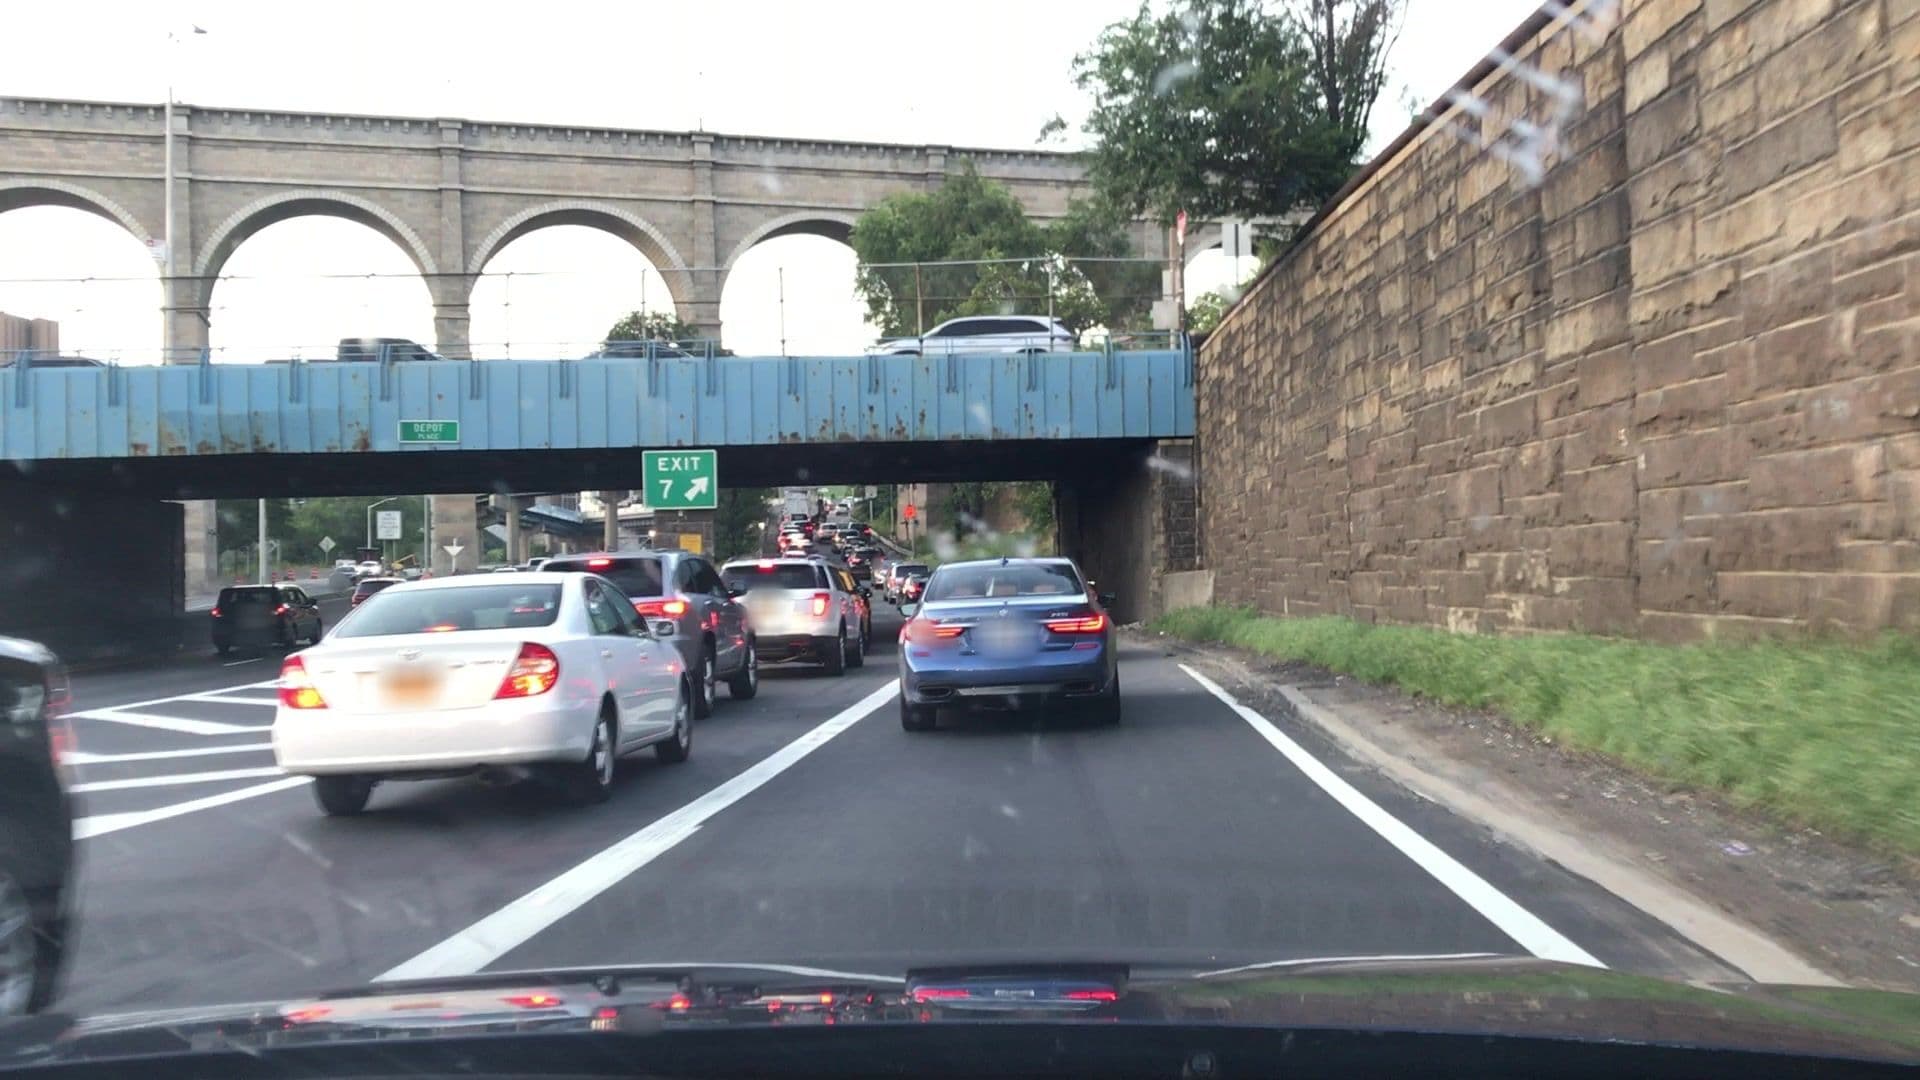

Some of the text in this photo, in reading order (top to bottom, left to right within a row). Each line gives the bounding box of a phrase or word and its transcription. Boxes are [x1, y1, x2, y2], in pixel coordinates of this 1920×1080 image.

[413, 423, 443, 433] DEPOT
[658, 457, 701, 471] EXIT
[659, 479, 673, 499] 7
